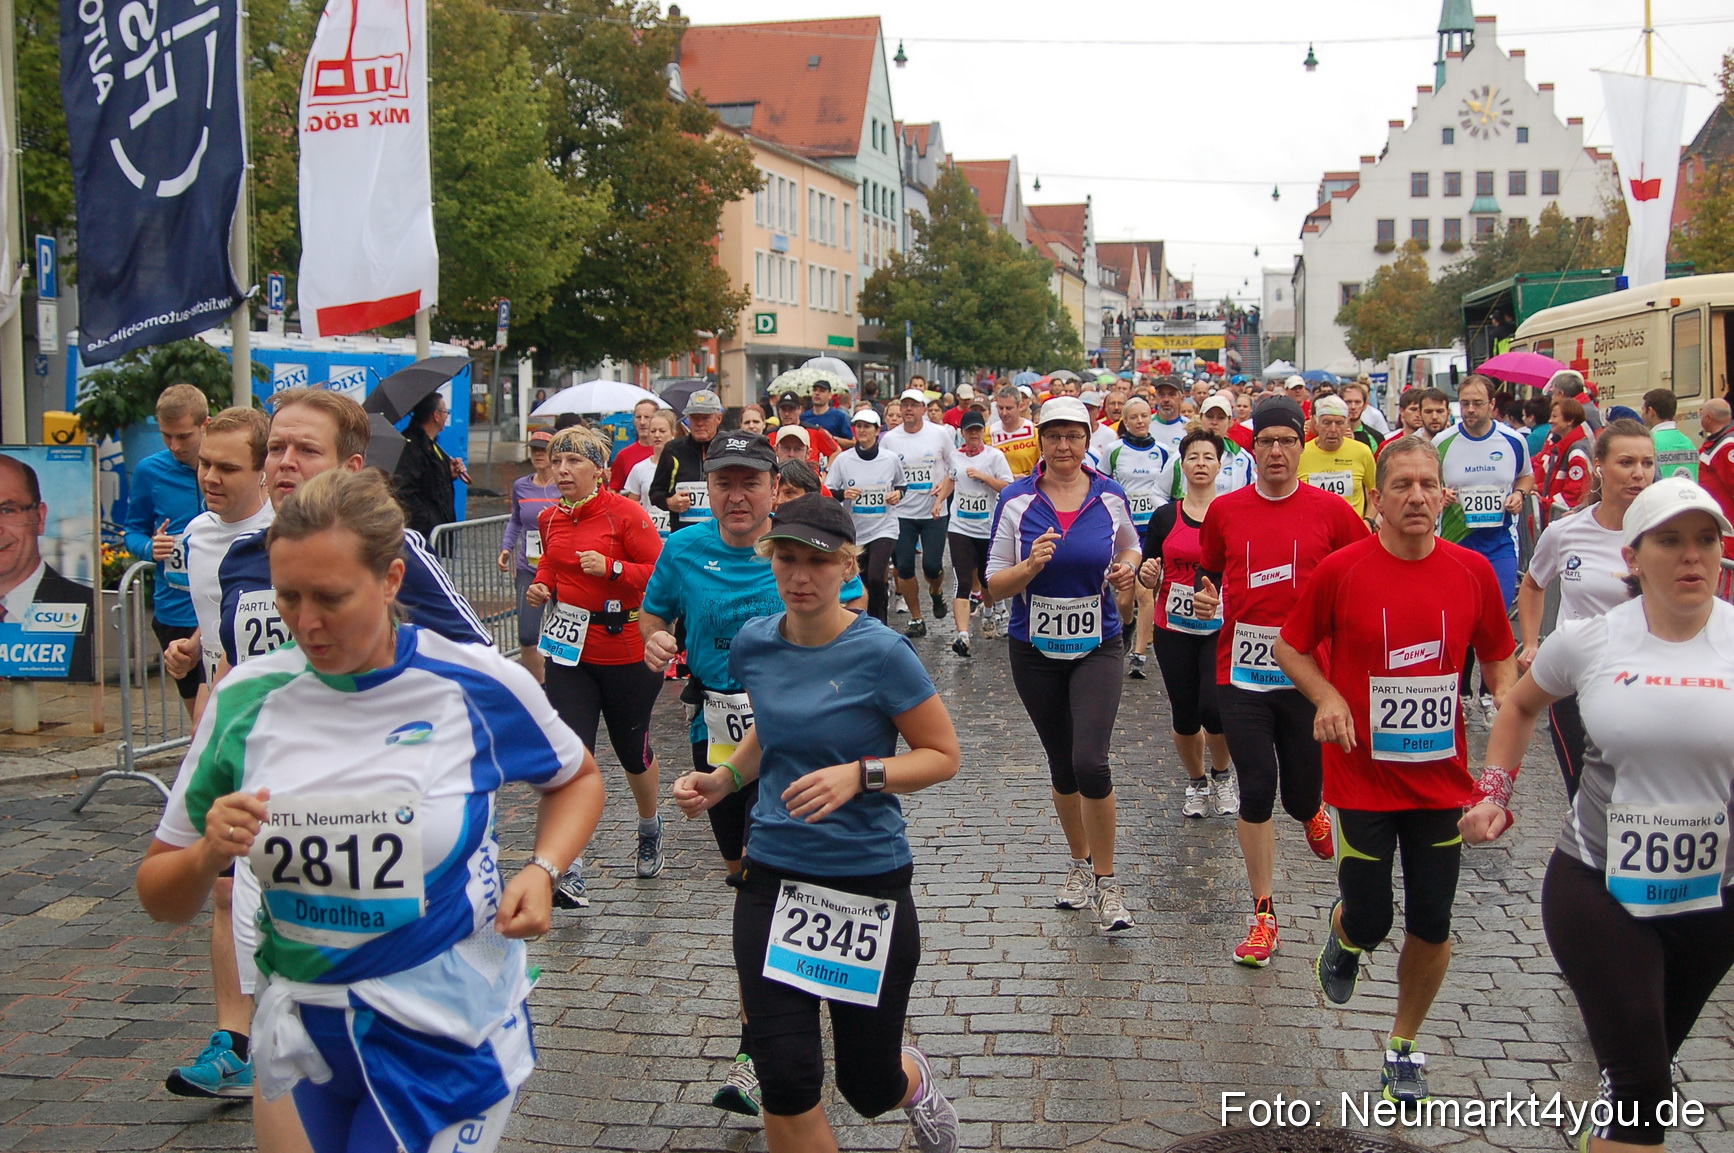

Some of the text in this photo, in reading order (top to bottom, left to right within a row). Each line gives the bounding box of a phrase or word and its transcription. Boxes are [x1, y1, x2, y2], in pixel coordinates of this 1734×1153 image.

[41, 244, 52, 291] P
[272, 279, 281, 307] P
[1164, 339, 1194, 347] START
[1594, 329, 1645, 356] Bayerisches
[1593, 358, 1617, 377] Rotes
[1596, 383, 1615, 401] reuz
[904, 470, 931, 482] 2134
[1464, 465, 1496, 473] Mathias
[689, 492, 710, 506] 97
[855, 493, 884, 505] 2133
[959, 497, 987, 511] 2140
[1128, 498, 1153, 512] 795
[1464, 495, 1502, 512] 2805
[1261, 571, 1281, 581] DEHN
[239, 602, 269, 612] PARTL
[1033, 601, 1055, 610] PARTL
[35, 612, 63, 622] CSU
[557, 608, 579, 620] eumarkt
[1037, 611, 1095, 635] 2109
[1181, 619, 1207, 629] Regina
[245, 617, 293, 657] 25
[1235, 629, 1257, 639] PARTL
[0, 643, 66, 662] ACKER
[1047, 641, 1084, 652] Dagmar
[1403, 648, 1426, 661] DEHN
[1250, 671, 1286, 683] Markus
[1645, 675, 1731, 690] KLEBL
[1372, 685, 1447, 694] PARTL Neumarkt
[706, 699, 725, 709] PARTL
[1380, 695, 1452, 729] 2289
[1403, 738, 1434, 750] Peter
[260, 810, 387, 827] ARTL Neumarkt
[1610, 813, 1711, 827] PARTL Neumarkt
[1619, 830, 1719, 874] 2693
[264, 833, 404, 890] 2812
[1646, 883, 1688, 902] Birgit
[782, 888, 873, 917] PARTL Neumarkt
[295, 898, 385, 928] Dorothea
[781, 907, 879, 962] 2345
[796, 958, 849, 985] Kathrin
